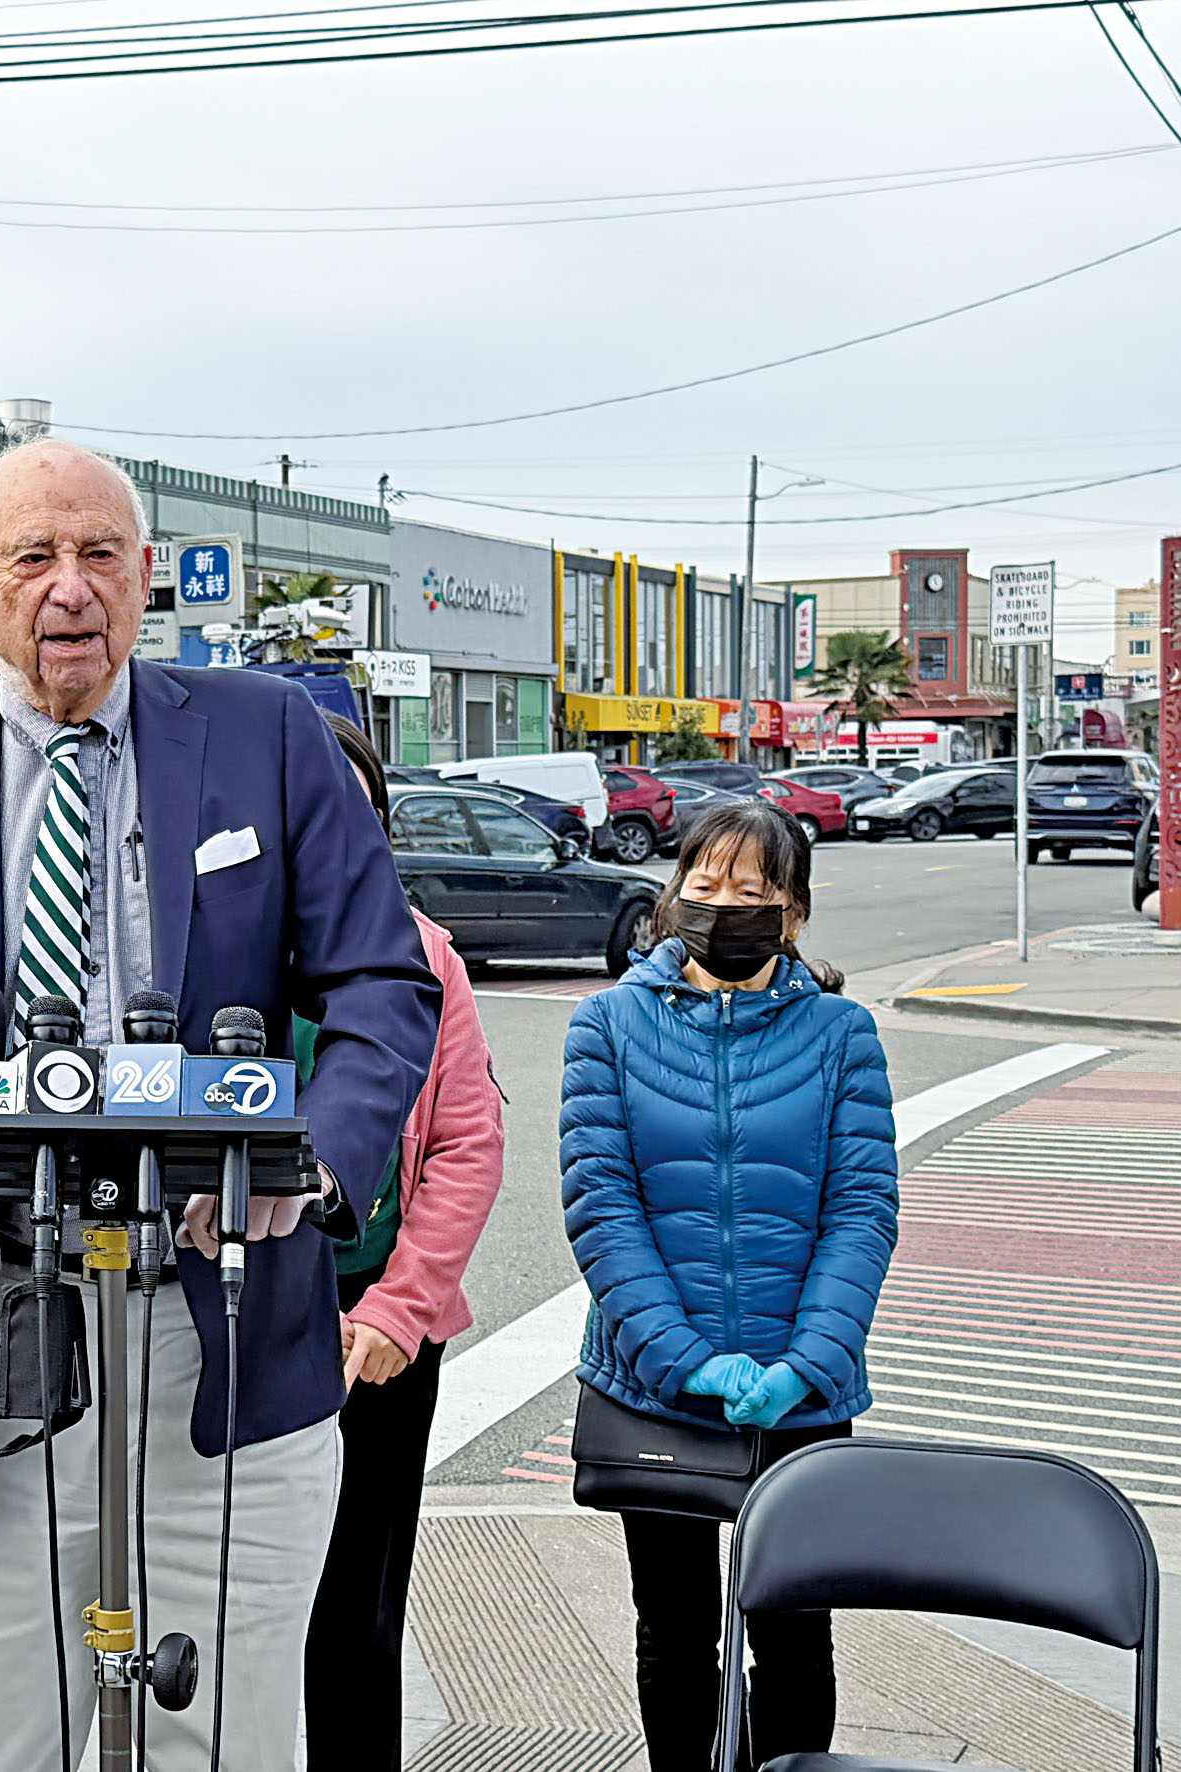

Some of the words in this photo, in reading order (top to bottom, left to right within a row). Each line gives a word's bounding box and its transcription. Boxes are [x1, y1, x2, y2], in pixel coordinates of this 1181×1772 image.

[995, 570, 1049, 584] SKATEBOARD
[996, 586, 1003, 597] &
[1009, 584, 1047, 597] BICYCLE
[1006, 599, 1038, 610] RIDING
[997, 611, 1047, 624] PROHIBITED
[993, 627, 1005, 638] ON
[1009, 625, 1049, 637] SIDEWALK
[399, 660, 416, 675] KISS
[110, 1059, 176, 1104] 26
[203, 1088, 236, 1104] abc
[222, 1062, 277, 1115] 7
